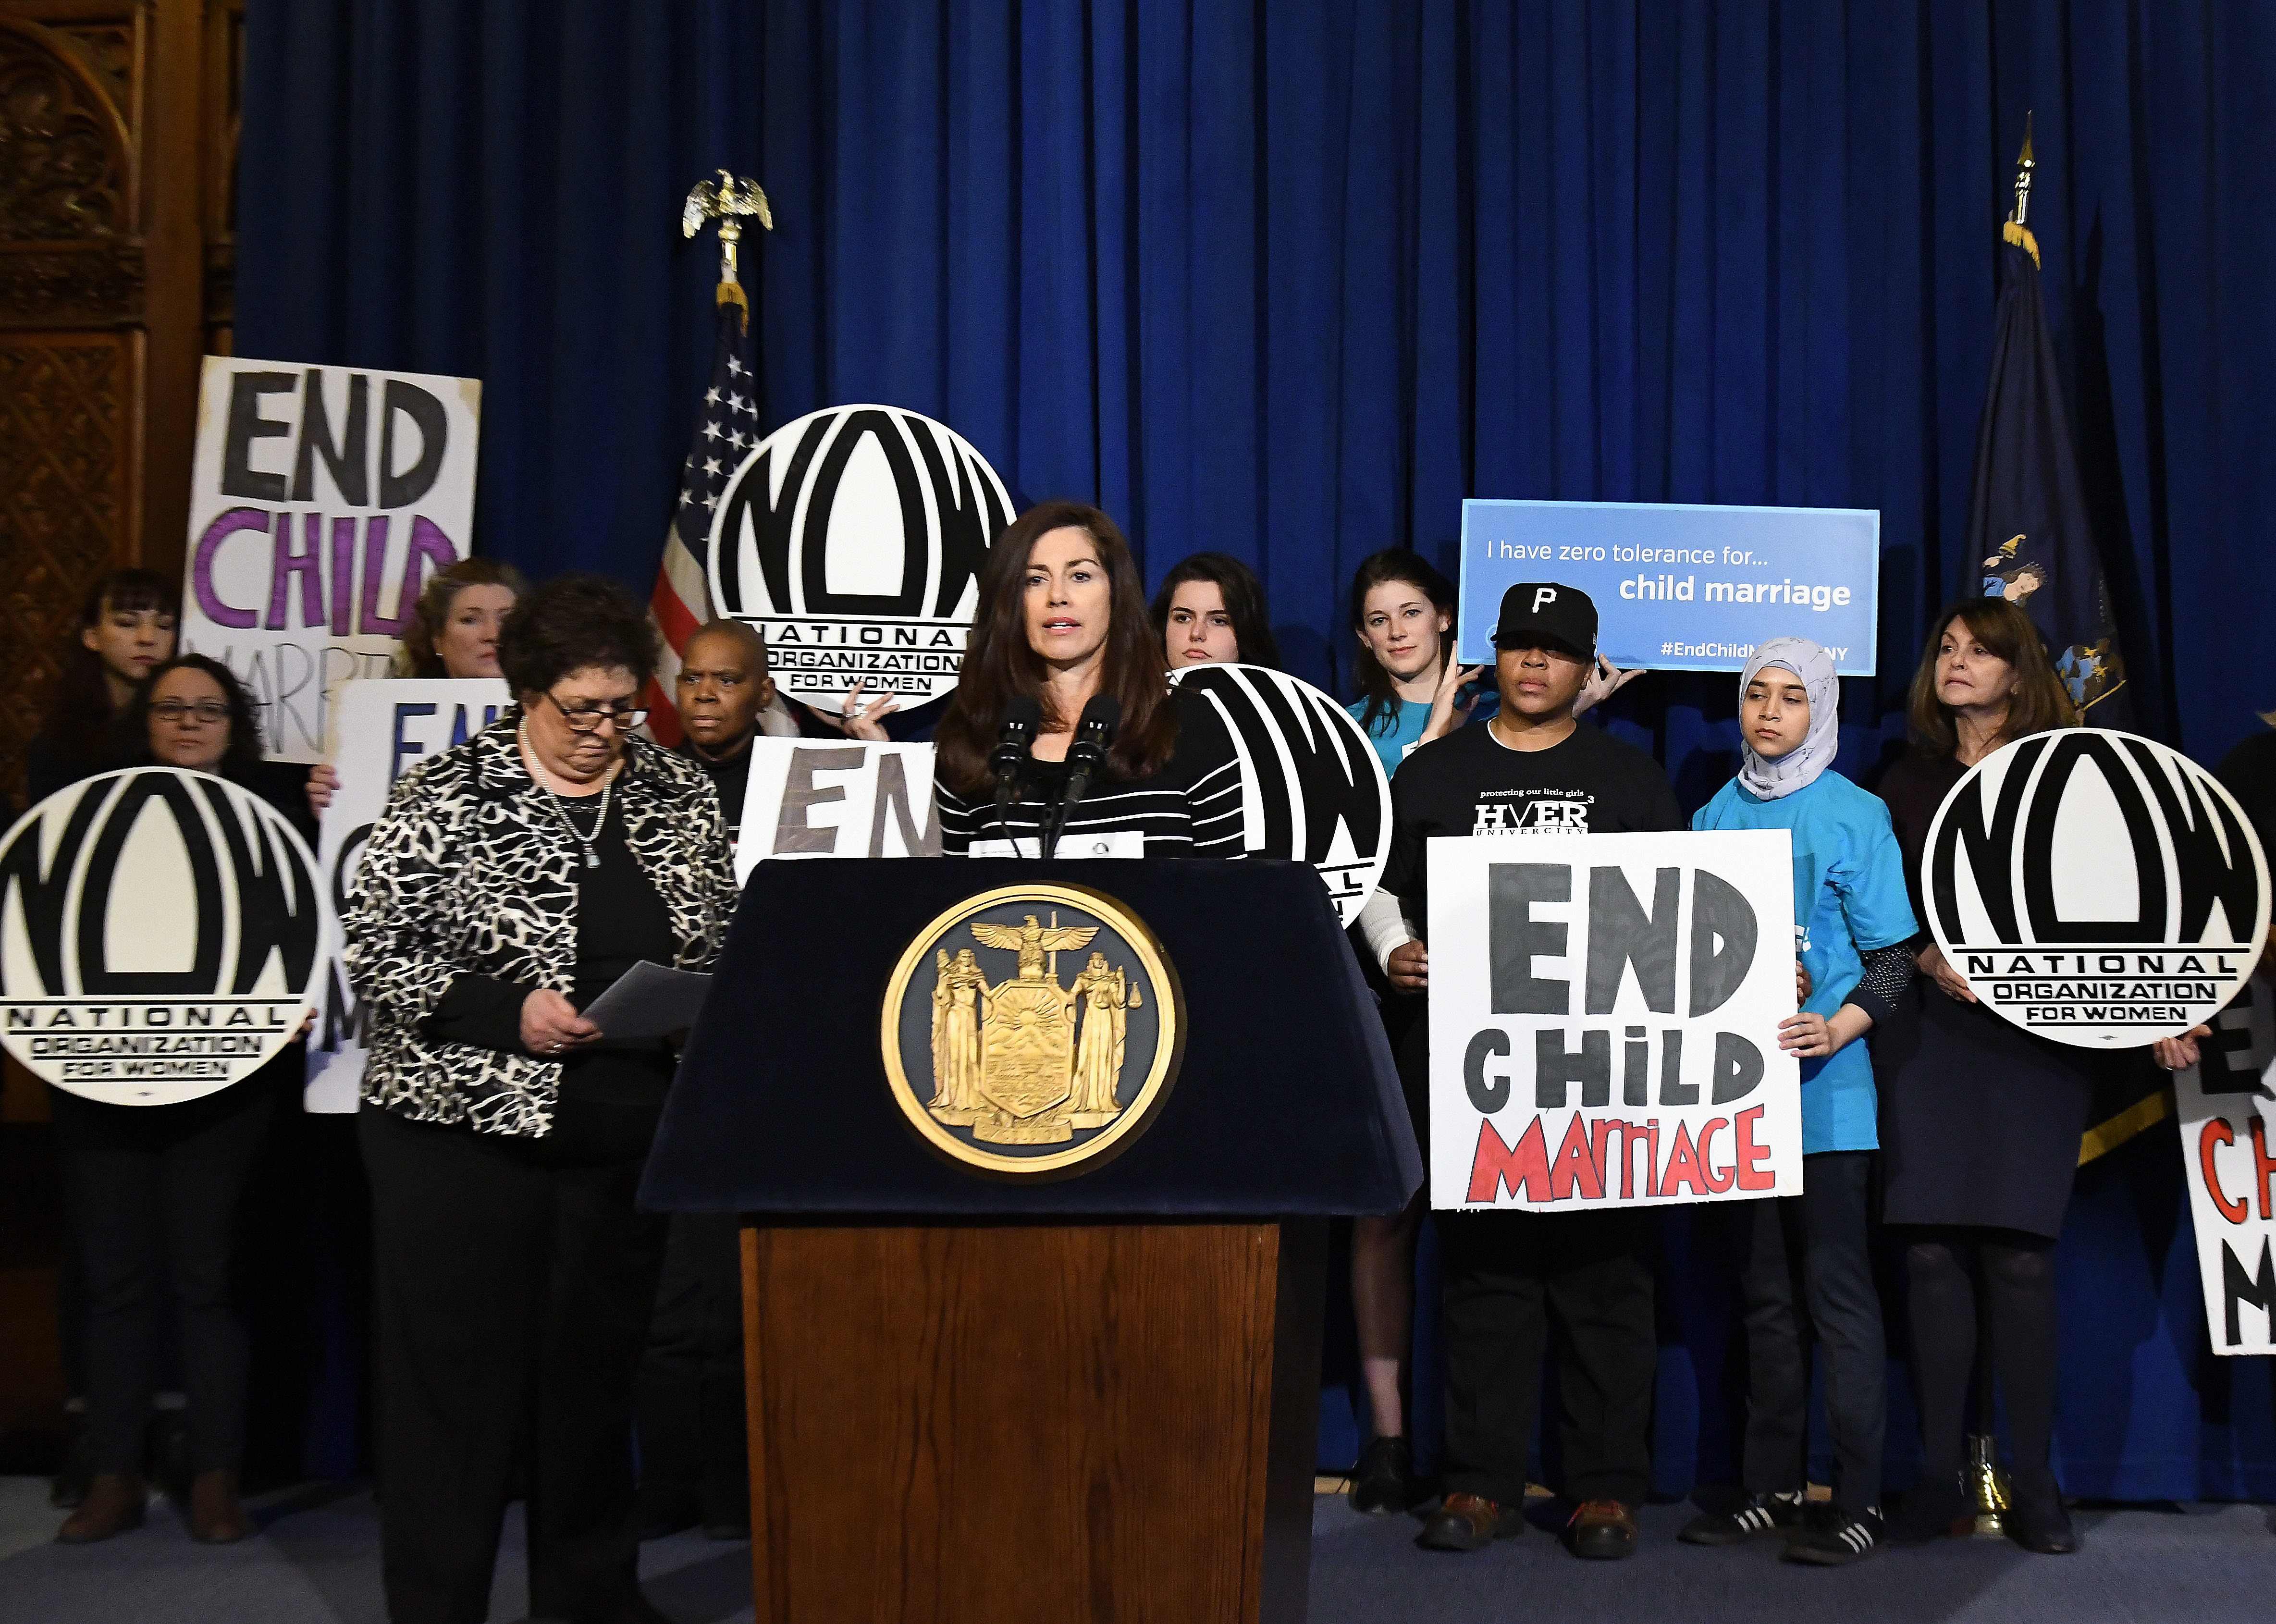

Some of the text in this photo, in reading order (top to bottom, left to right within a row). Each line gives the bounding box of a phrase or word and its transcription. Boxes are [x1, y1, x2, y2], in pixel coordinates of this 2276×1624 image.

[222, 369, 448, 509] END
[721, 410, 1009, 618] NOW
[1488, 541, 1768, 566] I have zero tolerance for...
[194, 506, 458, 639] CHILD
[1532, 588, 1557, 613] P
[1619, 574, 1851, 612] child marriage
[761, 624, 954, 647] ATIONA
[767, 650, 960, 671] ORGANIZATION
[790, 674, 932, 690] FOR WOMEN
[772, 746, 944, 858] EN
[1480, 788, 1525, 799] protecting
[1543, 787, 1564, 796] little
[1565, 789, 1584, 798] girls
[1476, 828, 1584, 836] UNIVERCITY
[1932, 733, 2259, 945] NOW
[0, 772, 318, 996] NOW
[1489, 863, 1758, 1018] END
[1969, 955, 2237, 974] NATIONAL
[1993, 983, 2216, 999] ORGANIZATION
[8, 1008, 287, 1027] NATIONAL
[2026, 1007, 2187, 1020] FOR WOMEN
